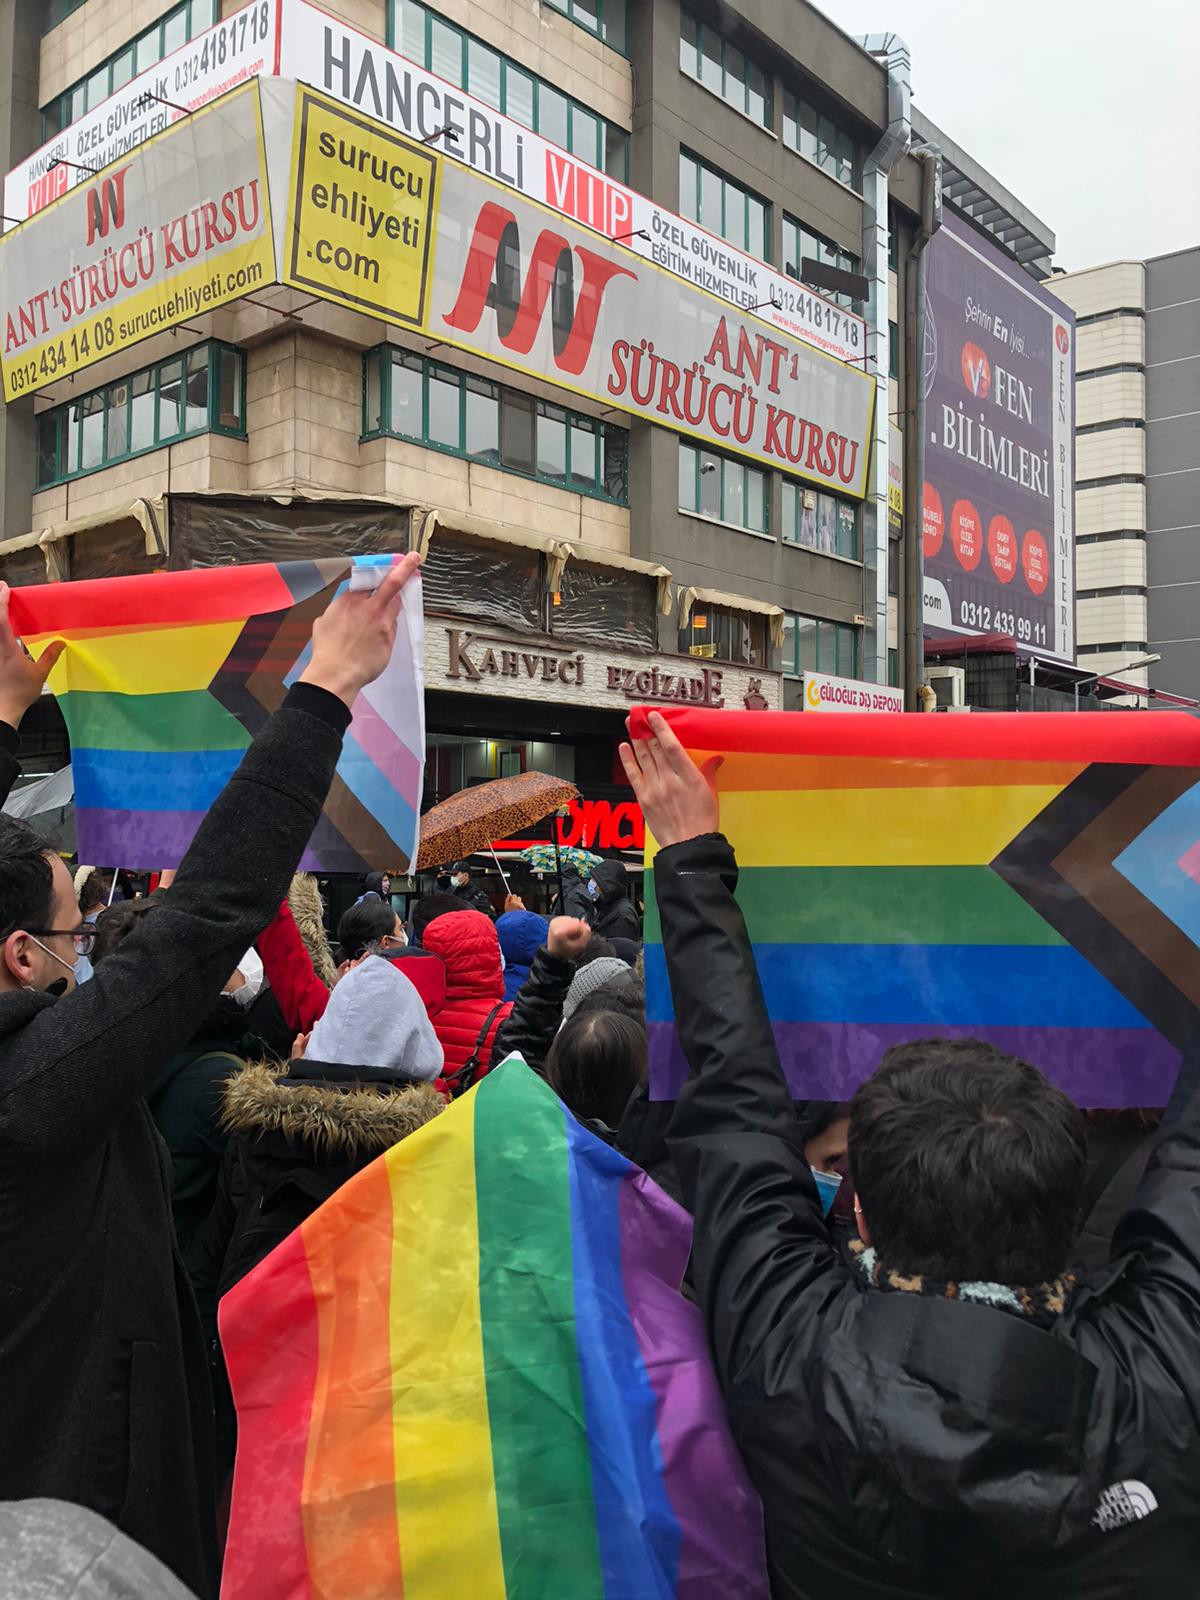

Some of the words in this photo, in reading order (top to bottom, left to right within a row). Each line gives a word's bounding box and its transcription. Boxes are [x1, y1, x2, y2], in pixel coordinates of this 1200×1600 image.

[76, 124, 105, 158] ÖZEL
[106, 76, 169, 137] GÜVENLİK
[107, 107, 169, 162] HİZMETLERİ
[318, 131, 424, 200] surucu
[311, 182, 420, 248] ehliyeti
[60, 226, 155, 322] SÜRÜCÜ
[161, 179, 259, 270] KURSU
[306, 240, 380, 283] .com
[651, 209, 689, 252] ÖZEL
[691, 236, 759, 290] GÜVENLİK
[651, 242, 692, 277] EĞİTİM
[694, 267, 759, 314] HİZMETLERİ
[11, 361, 37, 392] 0312
[39, 340, 67, 378] 434
[70, 327, 91, 362] 14
[93, 316, 114, 350] 08
[119, 262, 263, 340] surucuehliyeti.com
[964, 296, 992, 329] Şehrin
[992, 315, 1008, 344] En
[607, 338, 758, 445] SÜRÜCÜ
[763, 403, 860, 484] KURSU
[994, 364, 1033, 425] FEN
[960, 600, 991, 631] 0312
[993, 610, 1015, 637] 433
[1017, 616, 1032, 642] 99
[1034, 622, 1047, 646] 11
[872, 693, 903, 713] DEPOSU
